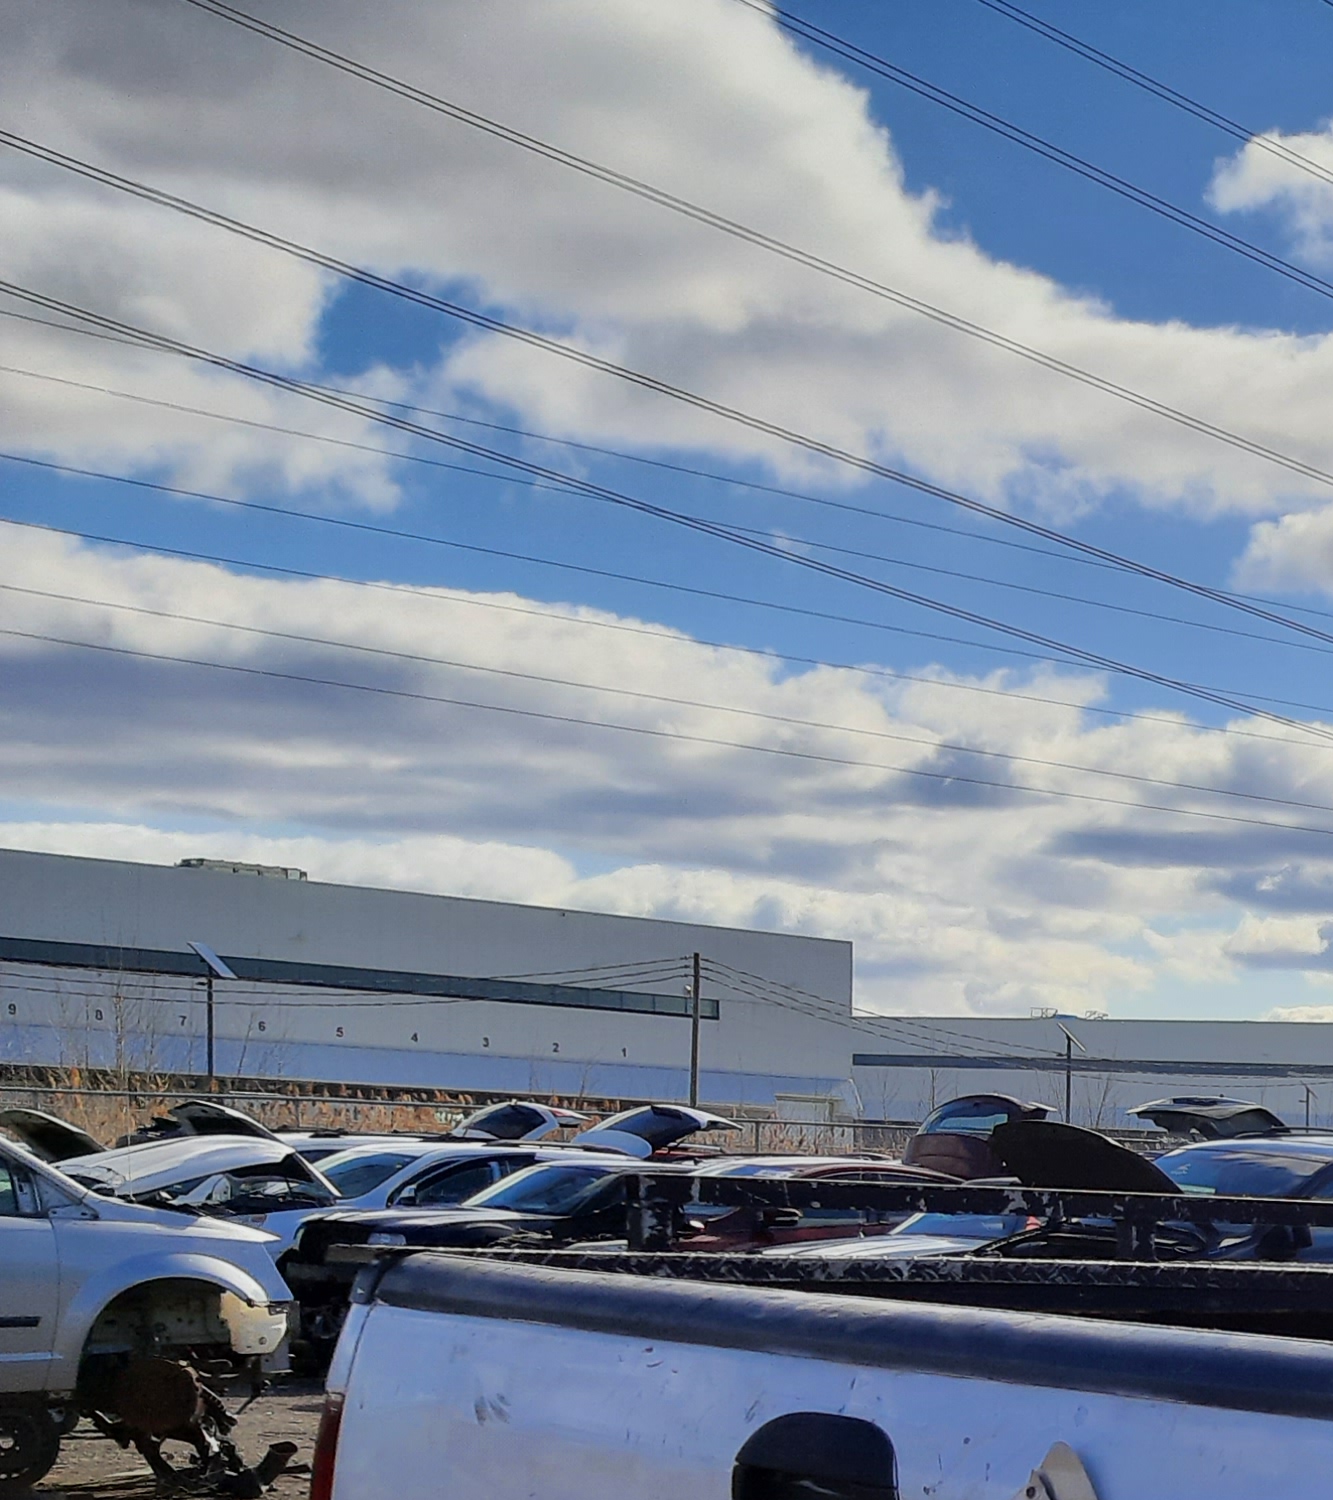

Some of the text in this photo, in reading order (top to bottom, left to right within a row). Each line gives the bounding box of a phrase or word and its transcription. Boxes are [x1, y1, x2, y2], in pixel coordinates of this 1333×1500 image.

[8, 1003, 17, 1015] 9
[95, 1009, 104, 1021] 8
[178, 1015, 187, 1026] 7
[258, 1021, 266, 1032] 6
[336, 1026, 344, 1038] 5
[411, 1032, 419, 1043] 4
[482, 1037, 490, 1048] 3
[552, 1042, 560, 1053] 2
[621, 1047, 627, 1058] 1
